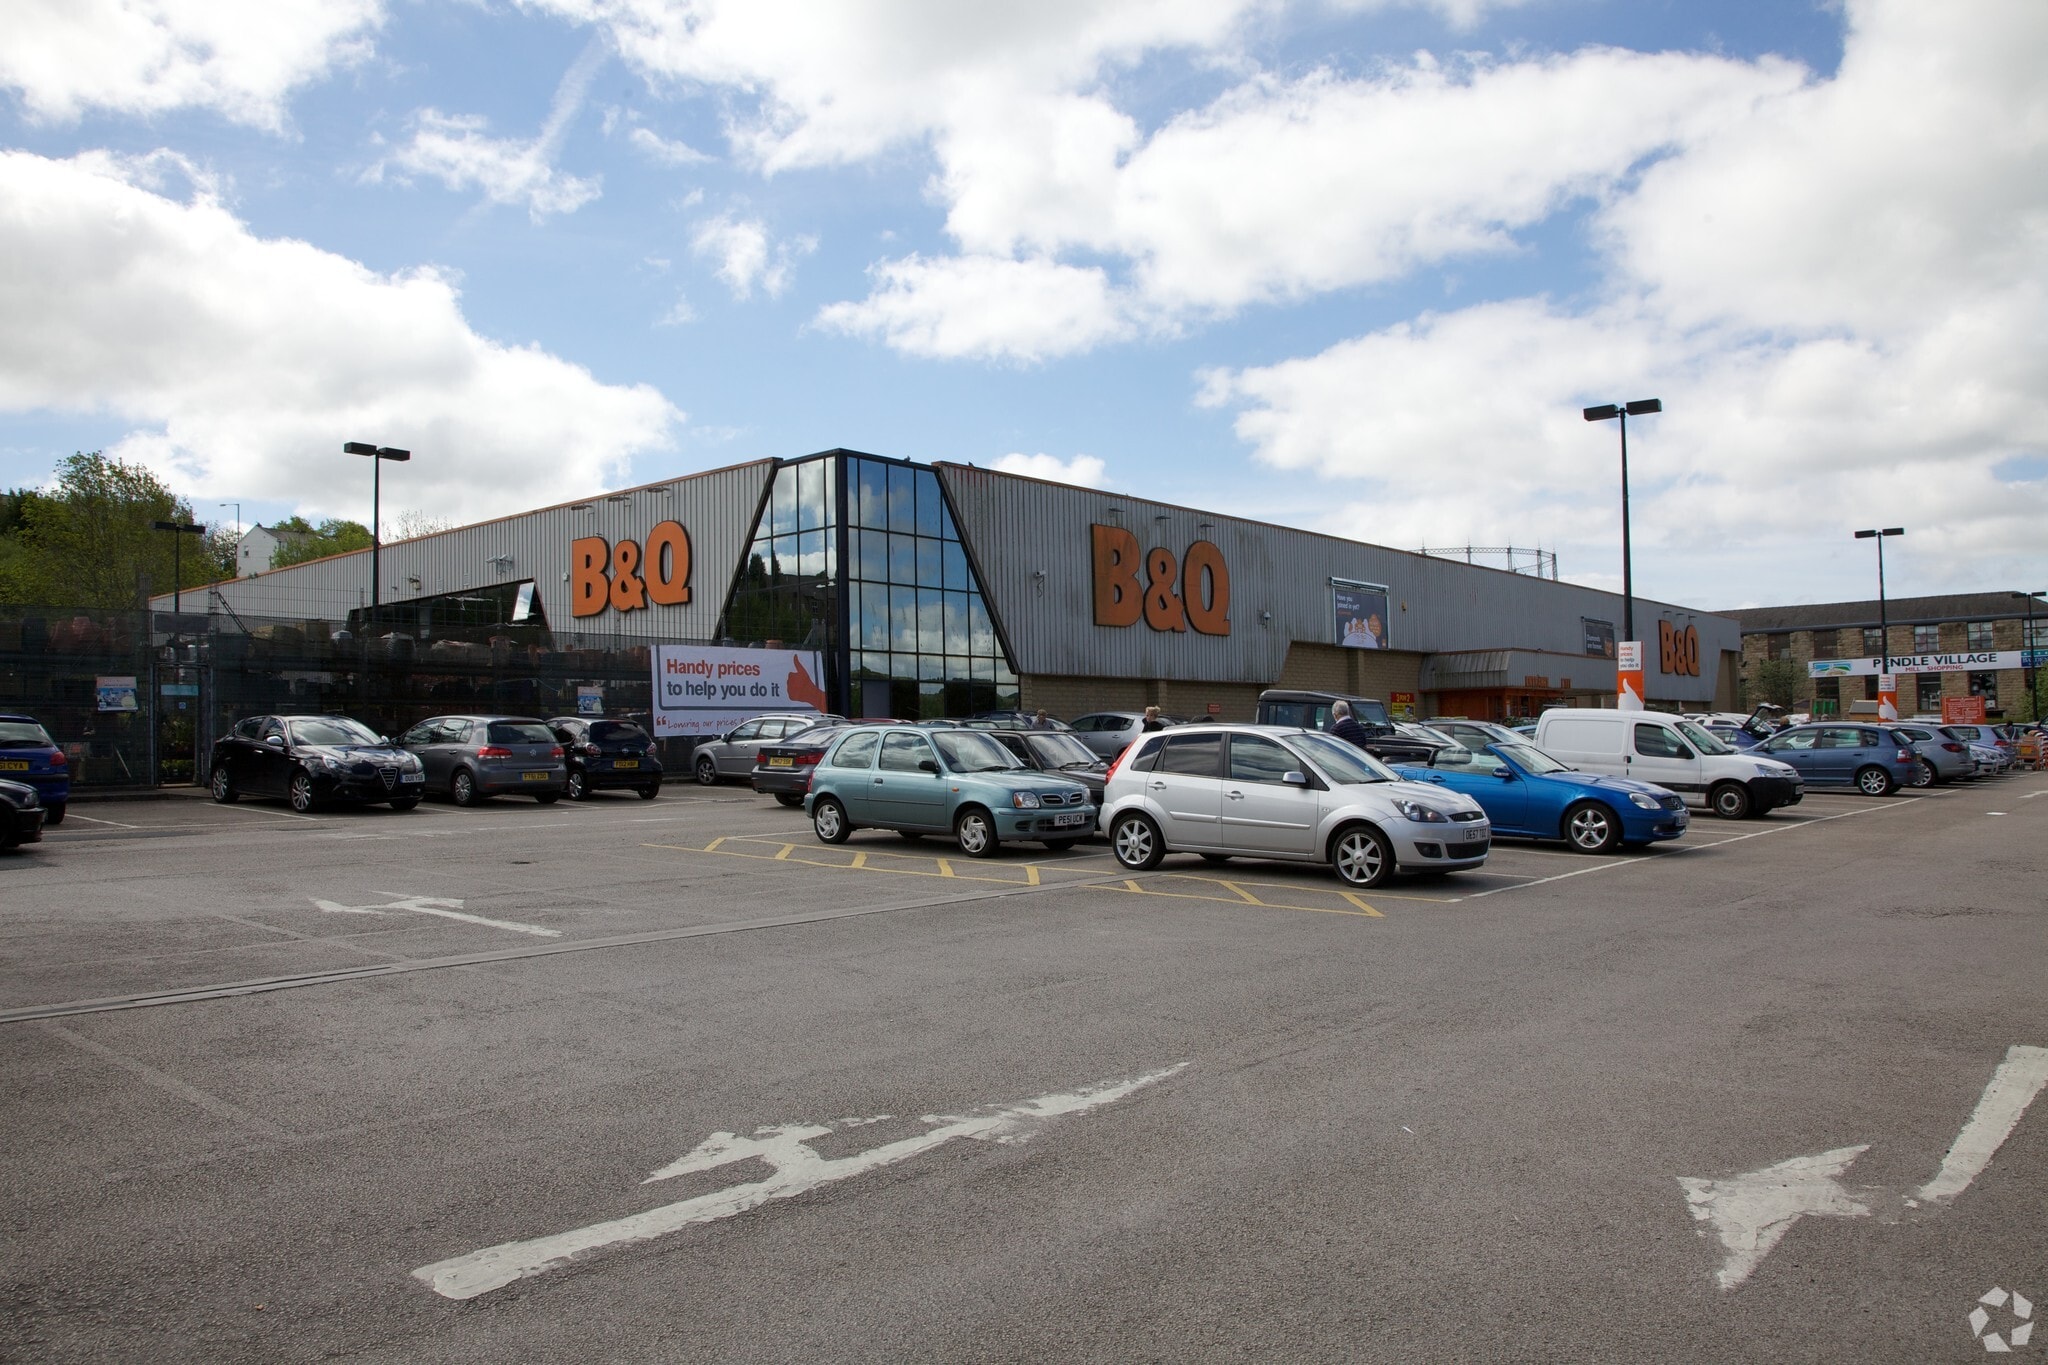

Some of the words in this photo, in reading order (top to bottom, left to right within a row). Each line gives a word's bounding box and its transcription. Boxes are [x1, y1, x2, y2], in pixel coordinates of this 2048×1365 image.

[572, 519, 692, 618] B&Q
[1090, 523, 1231, 636] B&Q
[1658, 619, 1700, 677] B&Q
[667, 658, 714, 679] Handy
[717, 662, 761, 679] prices
[1933, 653, 1997, 665] VILLAGE
[667, 681, 683, 696] to
[685, 680, 717, 700] help
[721, 684, 746, 700] you
[750, 683, 767, 697] do
[771, 682, 780, 697] it
[716, 717, 738, 730] prices
[7, 762, 24, 770] CYA
